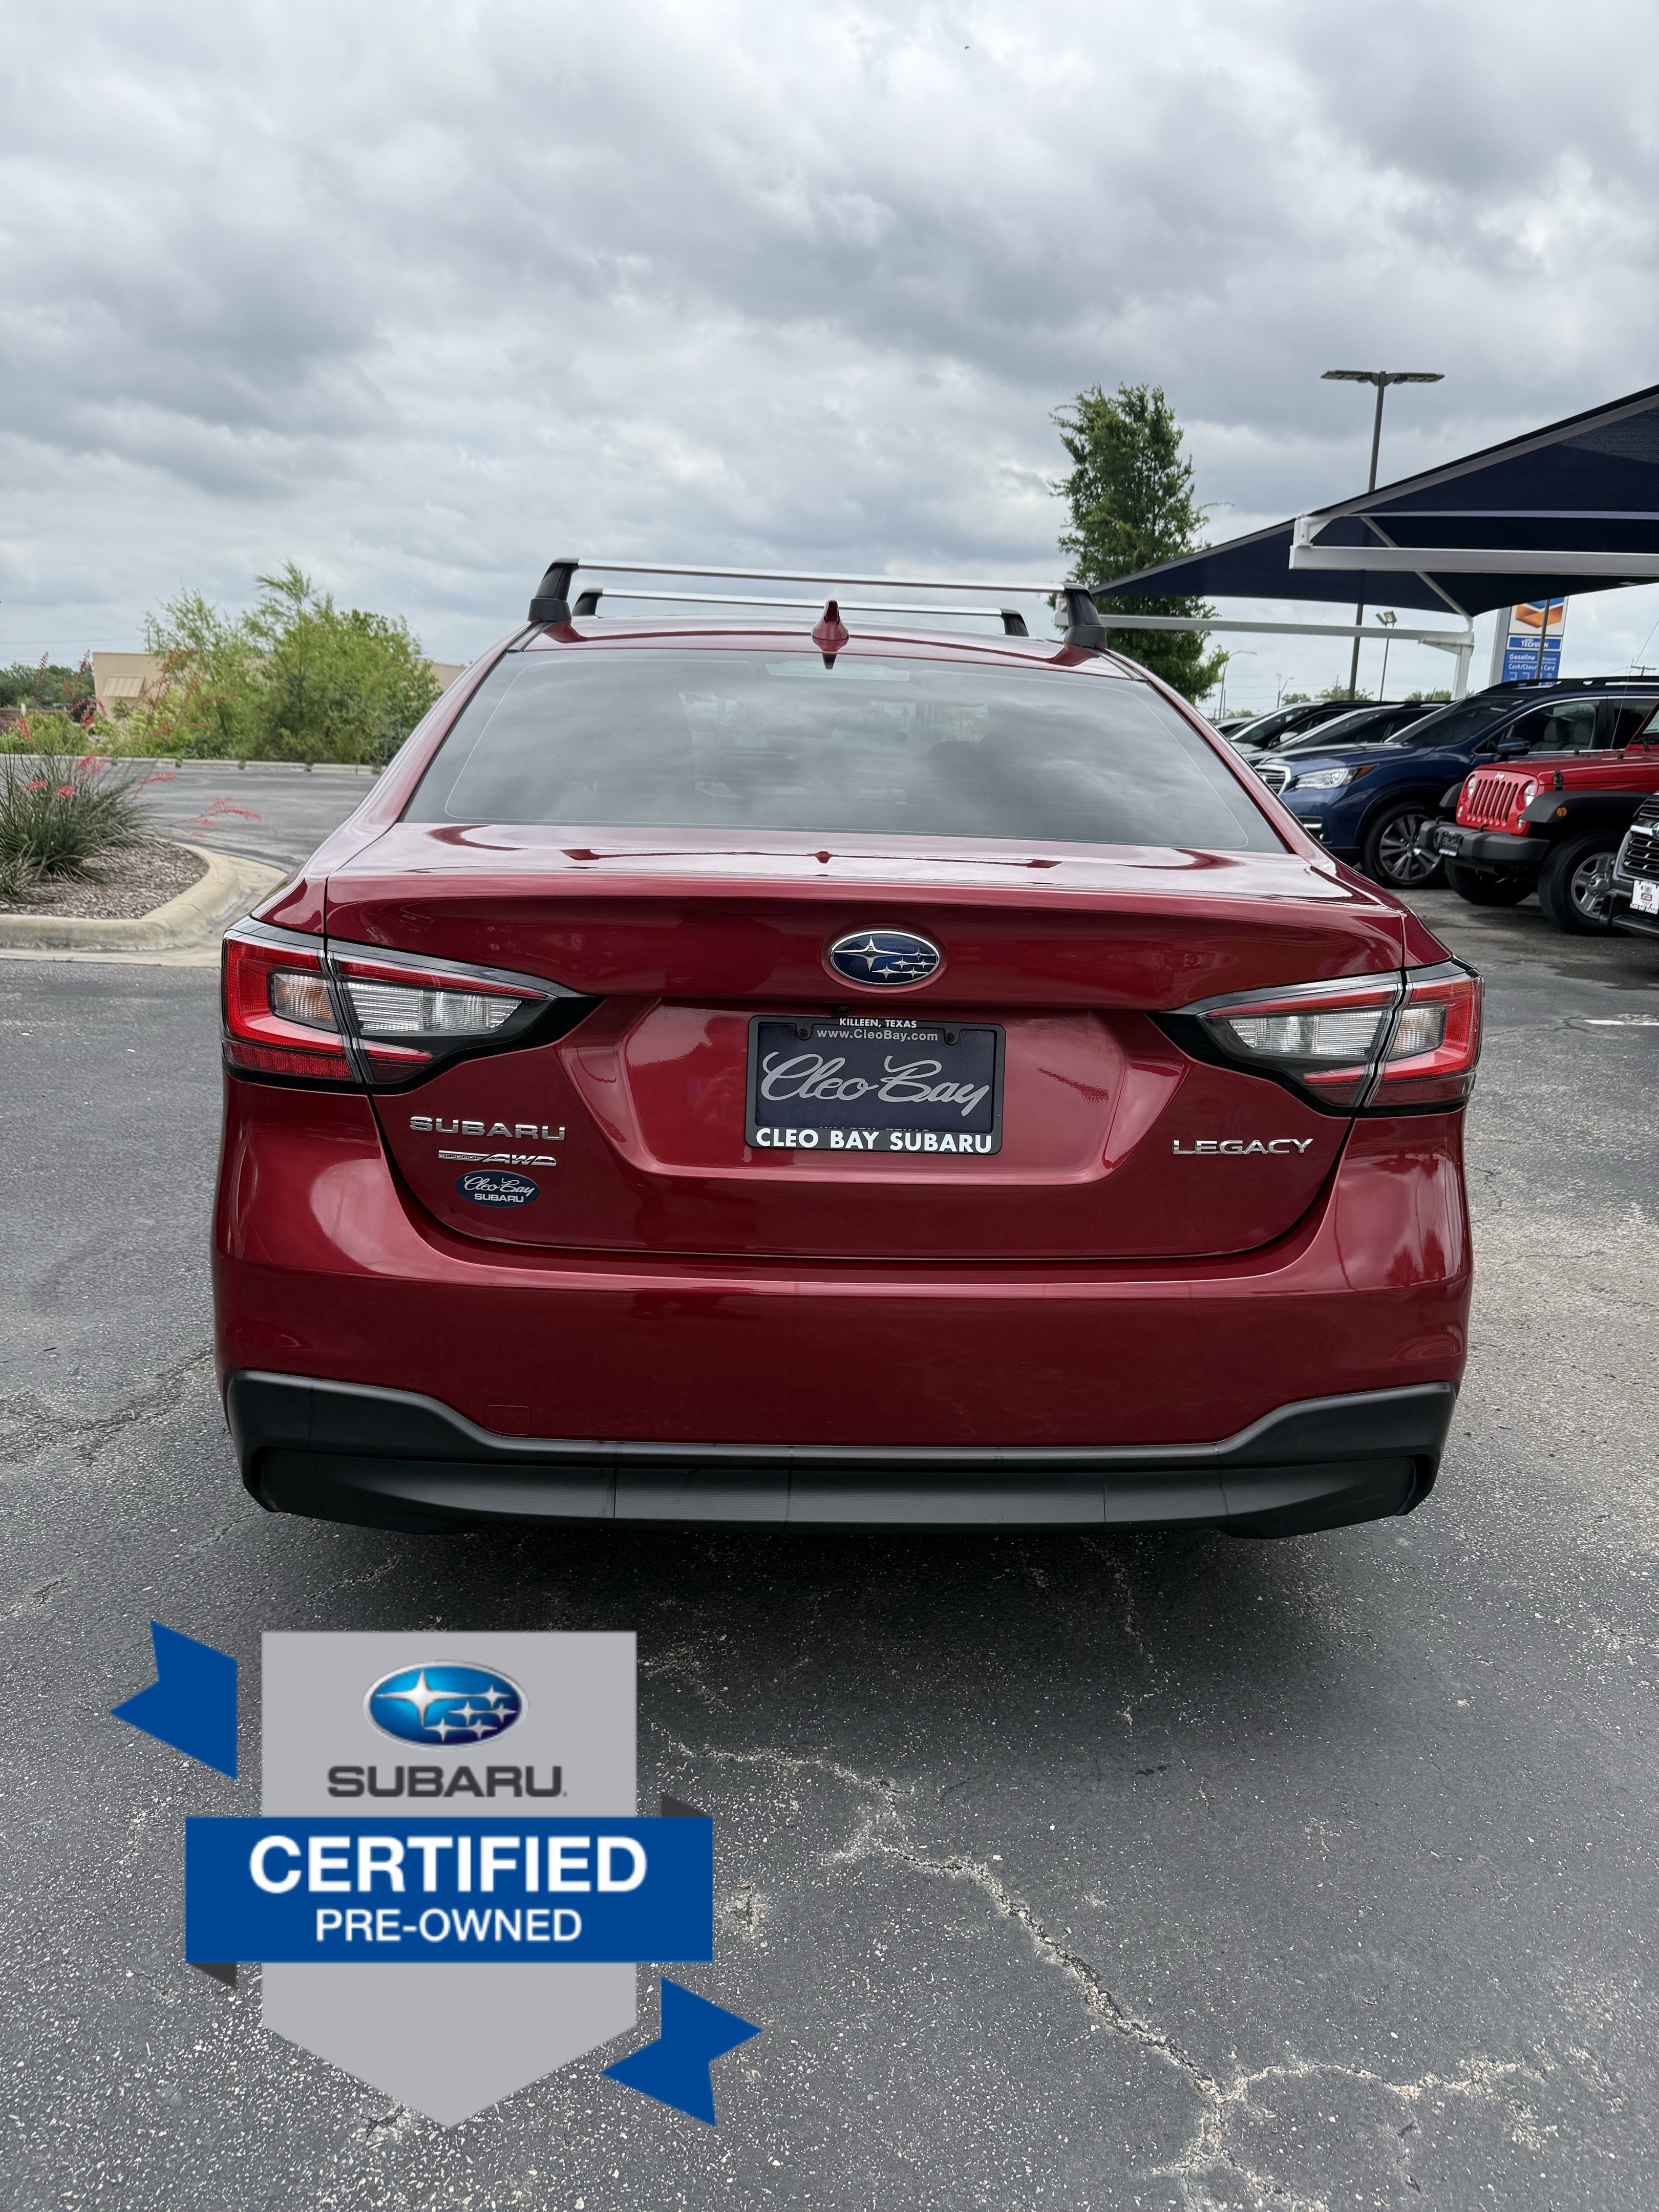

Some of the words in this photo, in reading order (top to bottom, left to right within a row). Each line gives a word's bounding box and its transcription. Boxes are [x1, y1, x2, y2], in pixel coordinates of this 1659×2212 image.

[1521, 640, 1549, 648] TECHRN
[839, 1018, 881, 1028] KILLEEN,
[885, 1019, 917, 1028] TEXAS
[817, 1028, 938, 1042] www.CleoBay.com
[761, 1051, 879, 1100] Cleo
[878, 1055, 990, 1116] Bay
[410, 1116, 565, 1141] SUBARU
[756, 1128, 819, 1148] CLEO
[830, 1130, 879, 1149] BAY
[889, 1132, 992, 1153] SUBARU
[1172, 1138, 1313, 1155] LEGACY
[482, 1153, 557, 1166] AWD
[464, 1175, 500, 1191] Cleo
[499, 1178, 535, 1197] Bay
[474, 1193, 524, 1203] SUBARU
